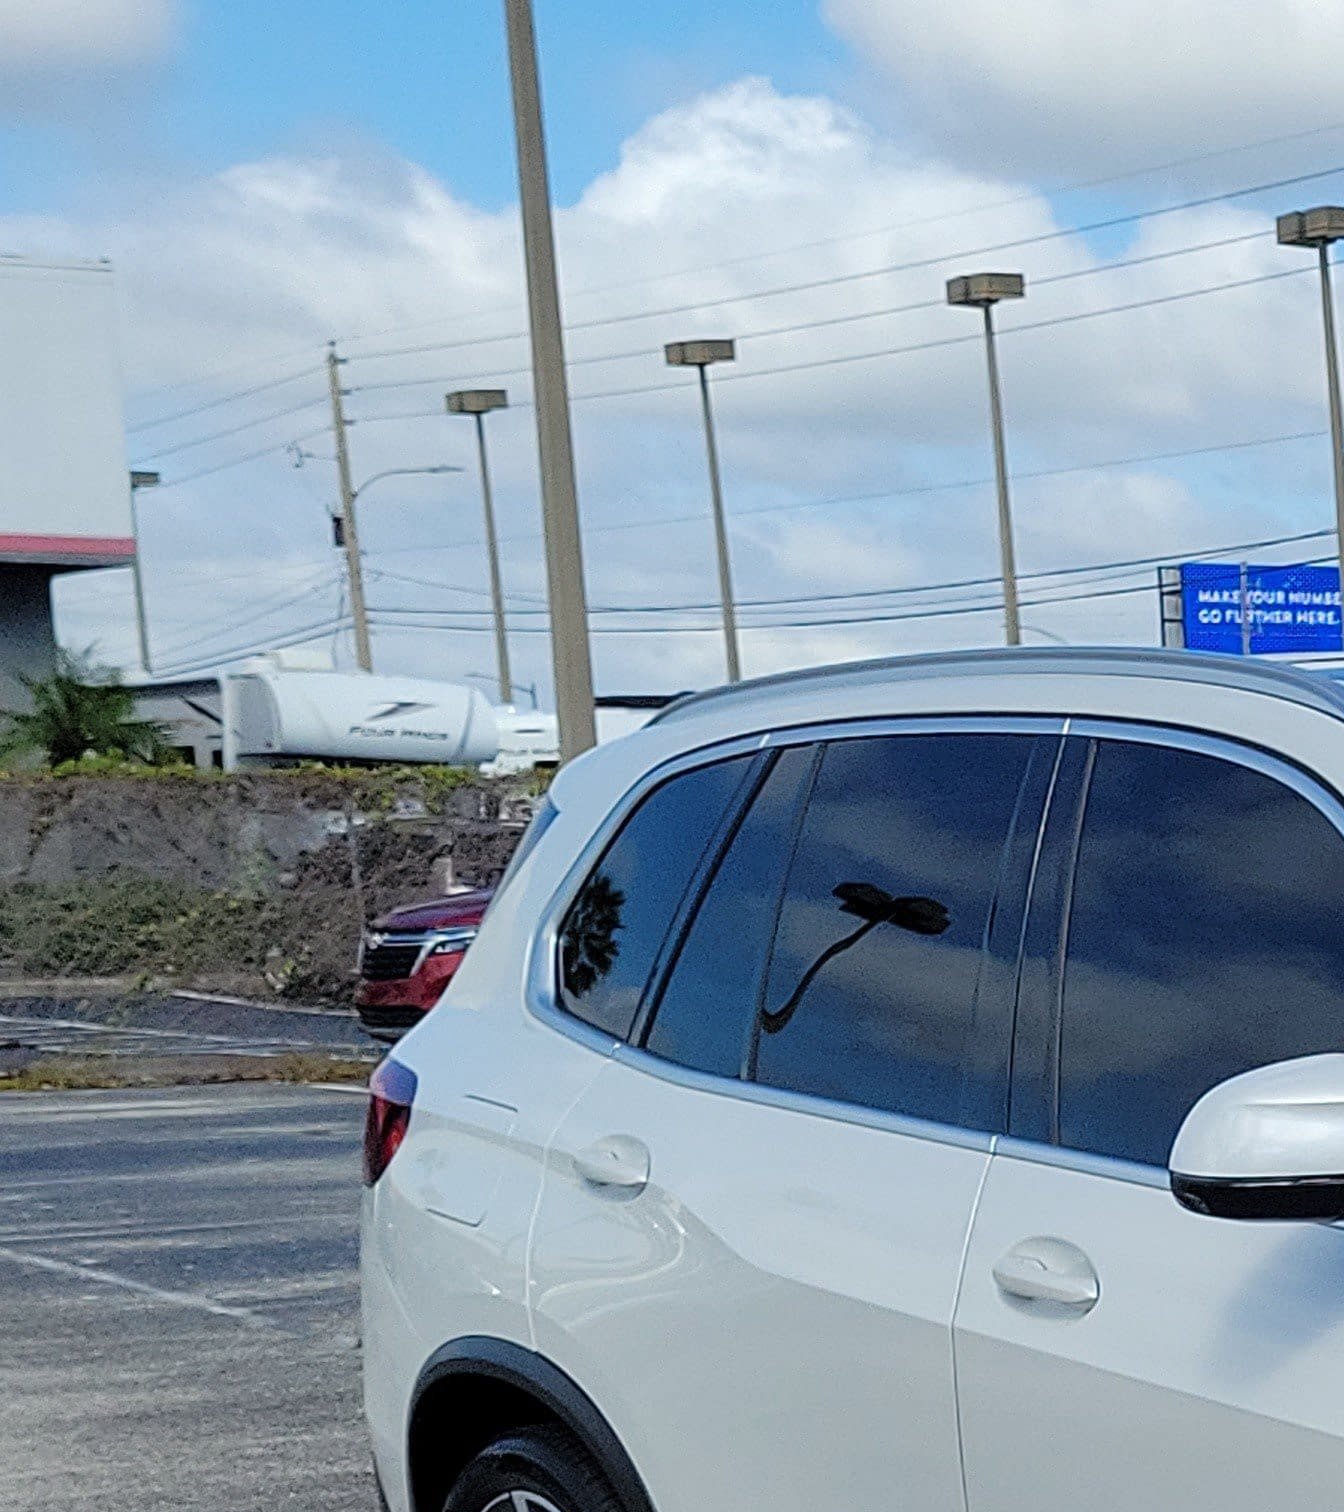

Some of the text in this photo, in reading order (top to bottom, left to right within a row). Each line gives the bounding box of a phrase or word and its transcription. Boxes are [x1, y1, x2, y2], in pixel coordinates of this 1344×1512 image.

[1198, 589, 1242, 603] MAKE
[1246, 590, 1286, 604] YOUR
[1198, 608, 1223, 624] GO
